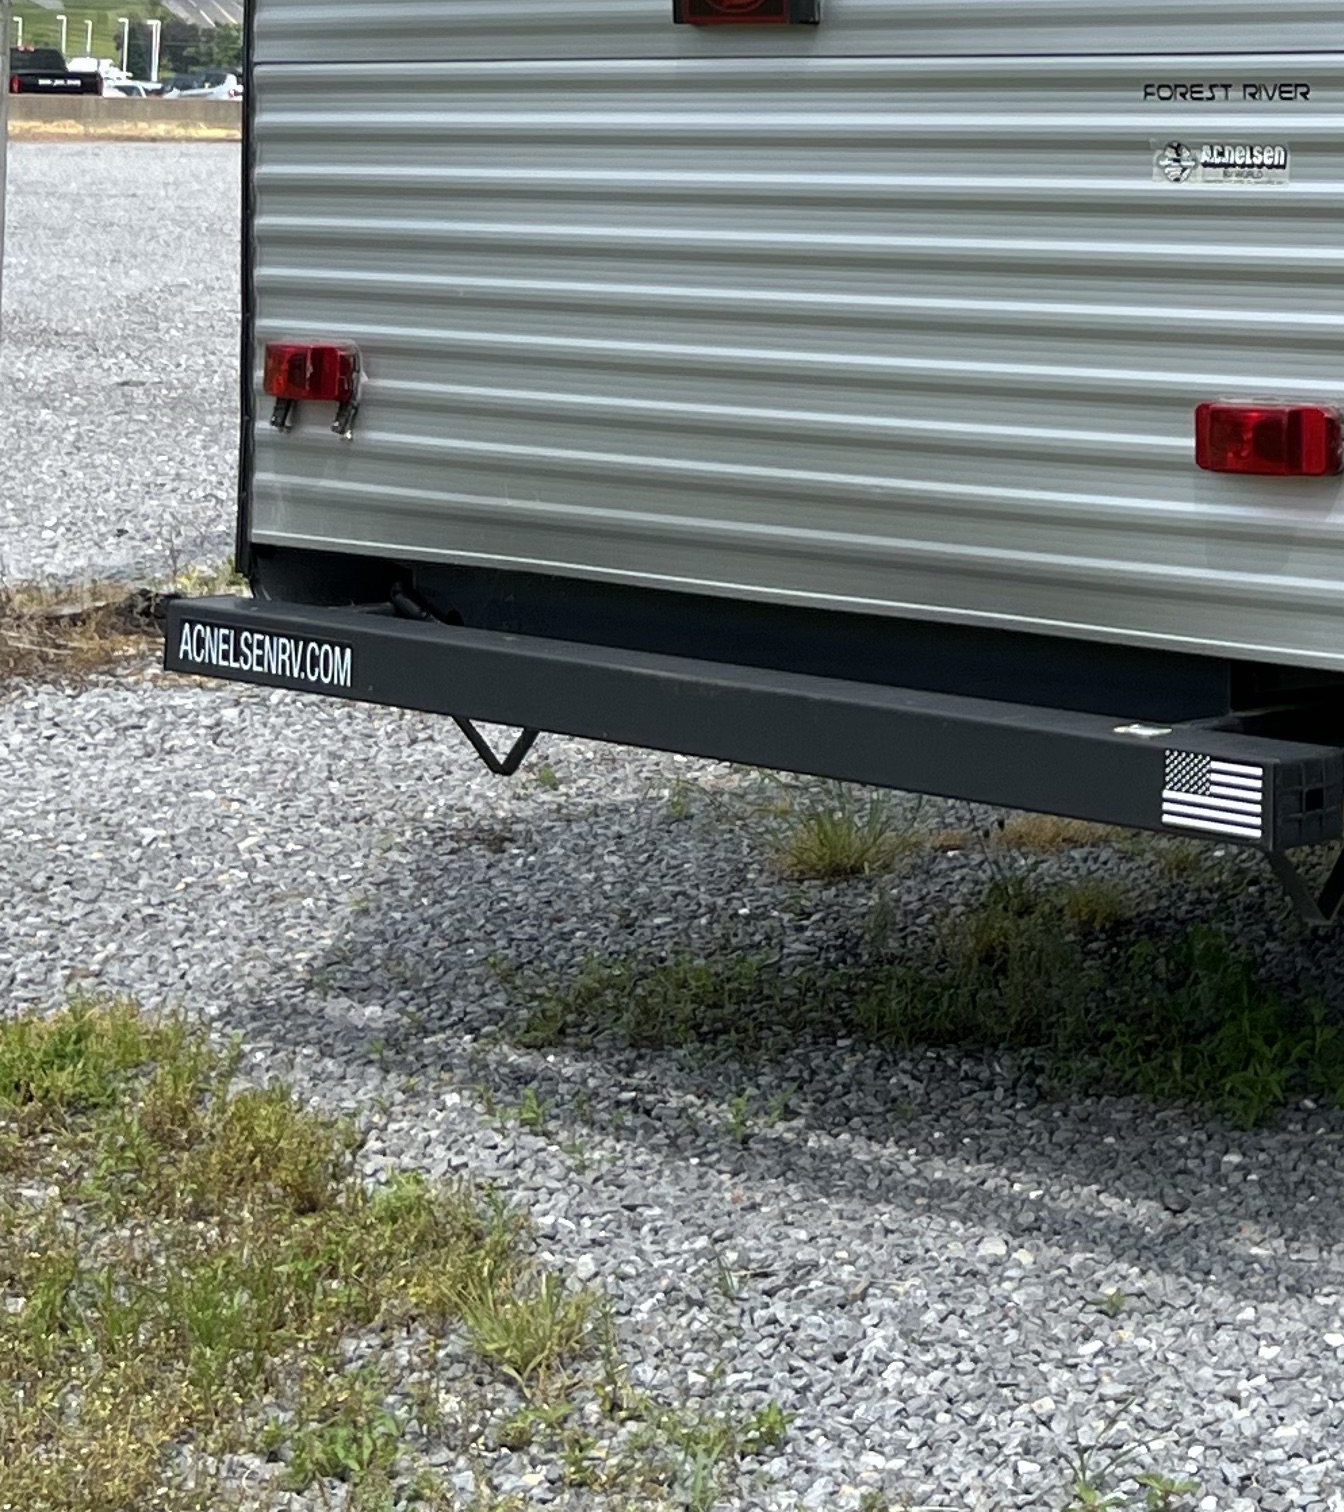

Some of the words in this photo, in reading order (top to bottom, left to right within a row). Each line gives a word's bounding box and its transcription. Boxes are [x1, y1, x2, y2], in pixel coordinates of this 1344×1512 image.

[1144, 83, 1232, 101] FOREST
[1243, 83, 1311, 101] RIVER
[179, 622, 352, 687] ACNELSENRV.COM
